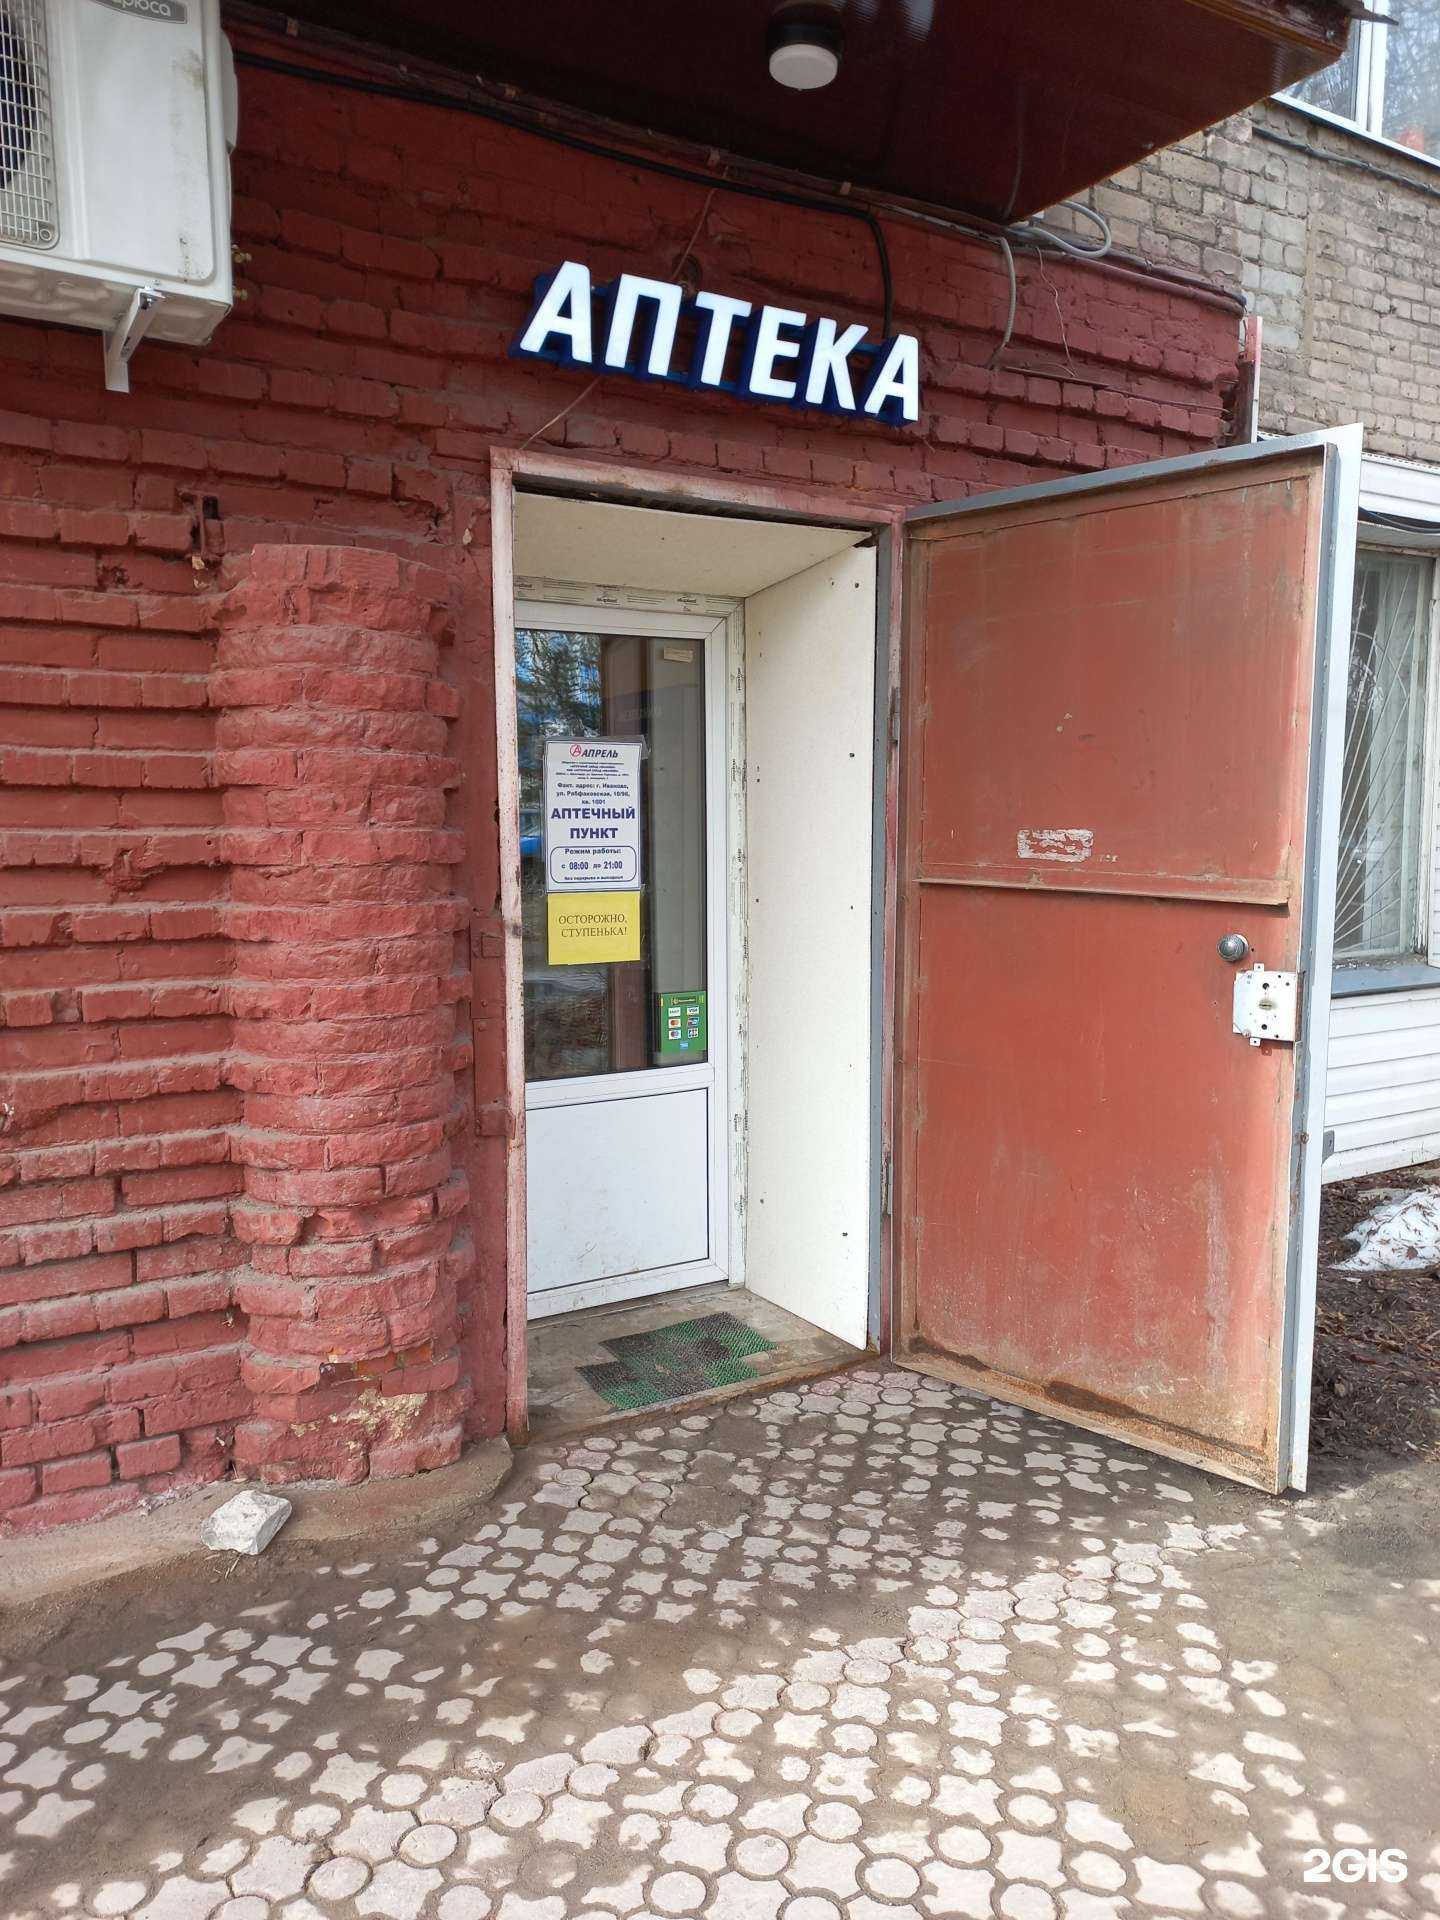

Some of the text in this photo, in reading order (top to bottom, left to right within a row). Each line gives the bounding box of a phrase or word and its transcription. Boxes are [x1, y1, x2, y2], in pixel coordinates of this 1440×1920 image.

[517, 260, 920, 422] АПТЕКА
[581, 749, 618, 758] АПРЕЛЬ
[551, 806, 635, 819] АПТЕЧНЫЙ
[570, 828, 619, 839] ПУНКТ
[569, 862, 589, 870] 08:00
[603, 861, 623, 869] 21:00
[558, 913, 628, 925] ОСТОРОЖНО,
[561, 926, 628, 938] СТУПЕНЬКА!
